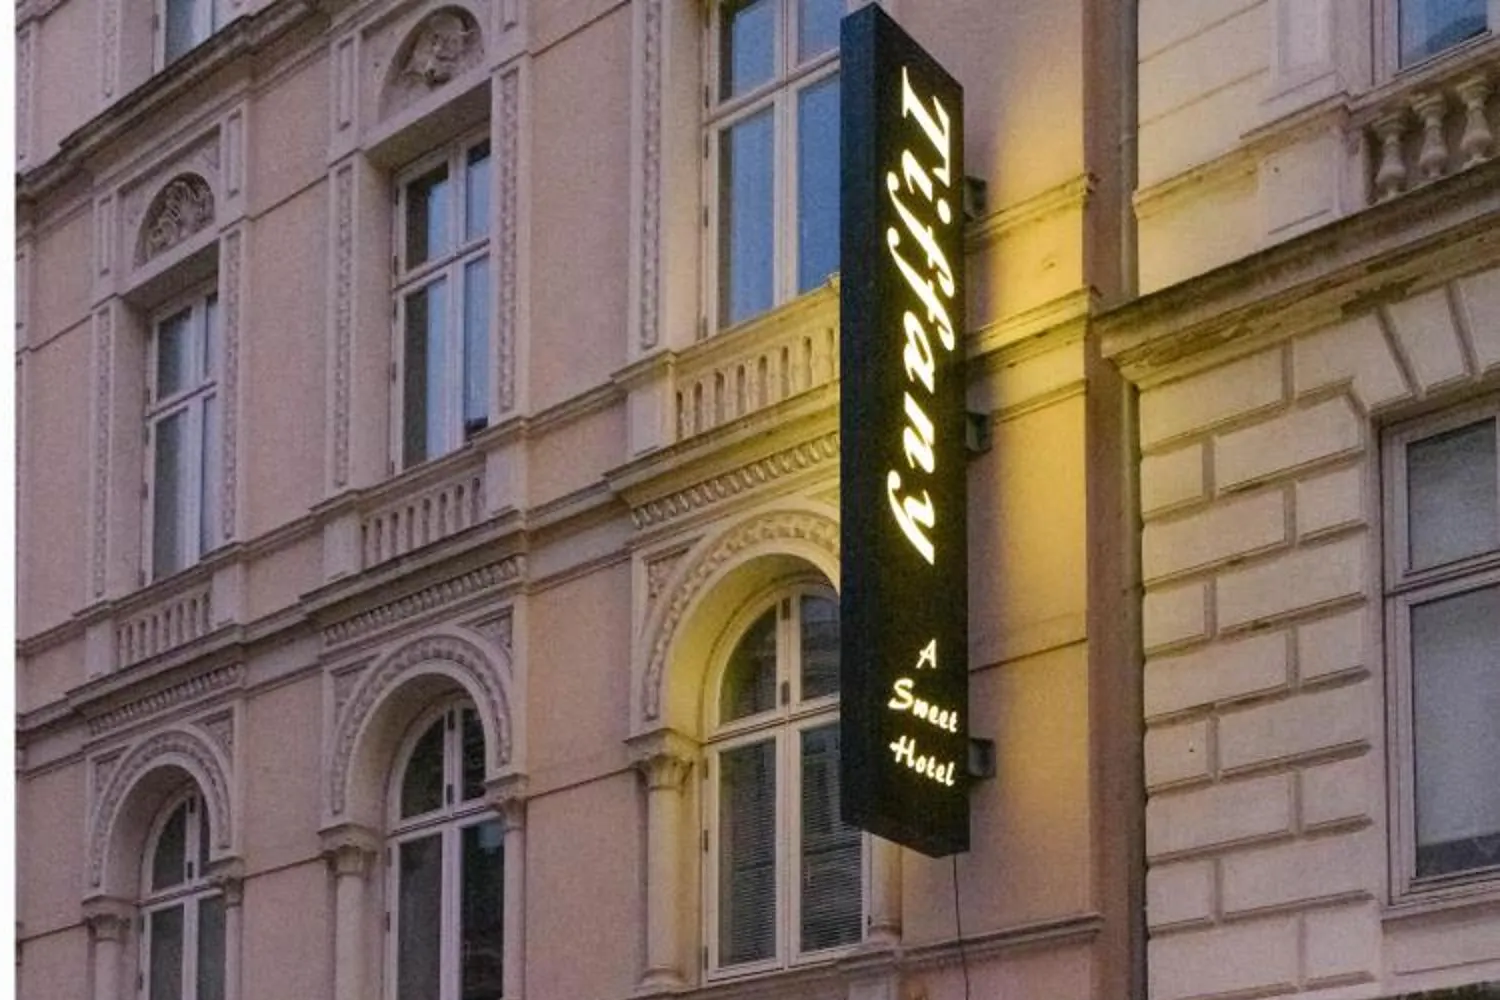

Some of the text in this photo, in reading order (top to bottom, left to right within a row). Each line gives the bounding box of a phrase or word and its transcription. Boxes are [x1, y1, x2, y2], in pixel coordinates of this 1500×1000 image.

[886, 65, 956, 564] Tiffany
[915, 638, 937, 669] A
[887, 677, 957, 733] Sweet
[889, 735, 955, 787] Hotel
